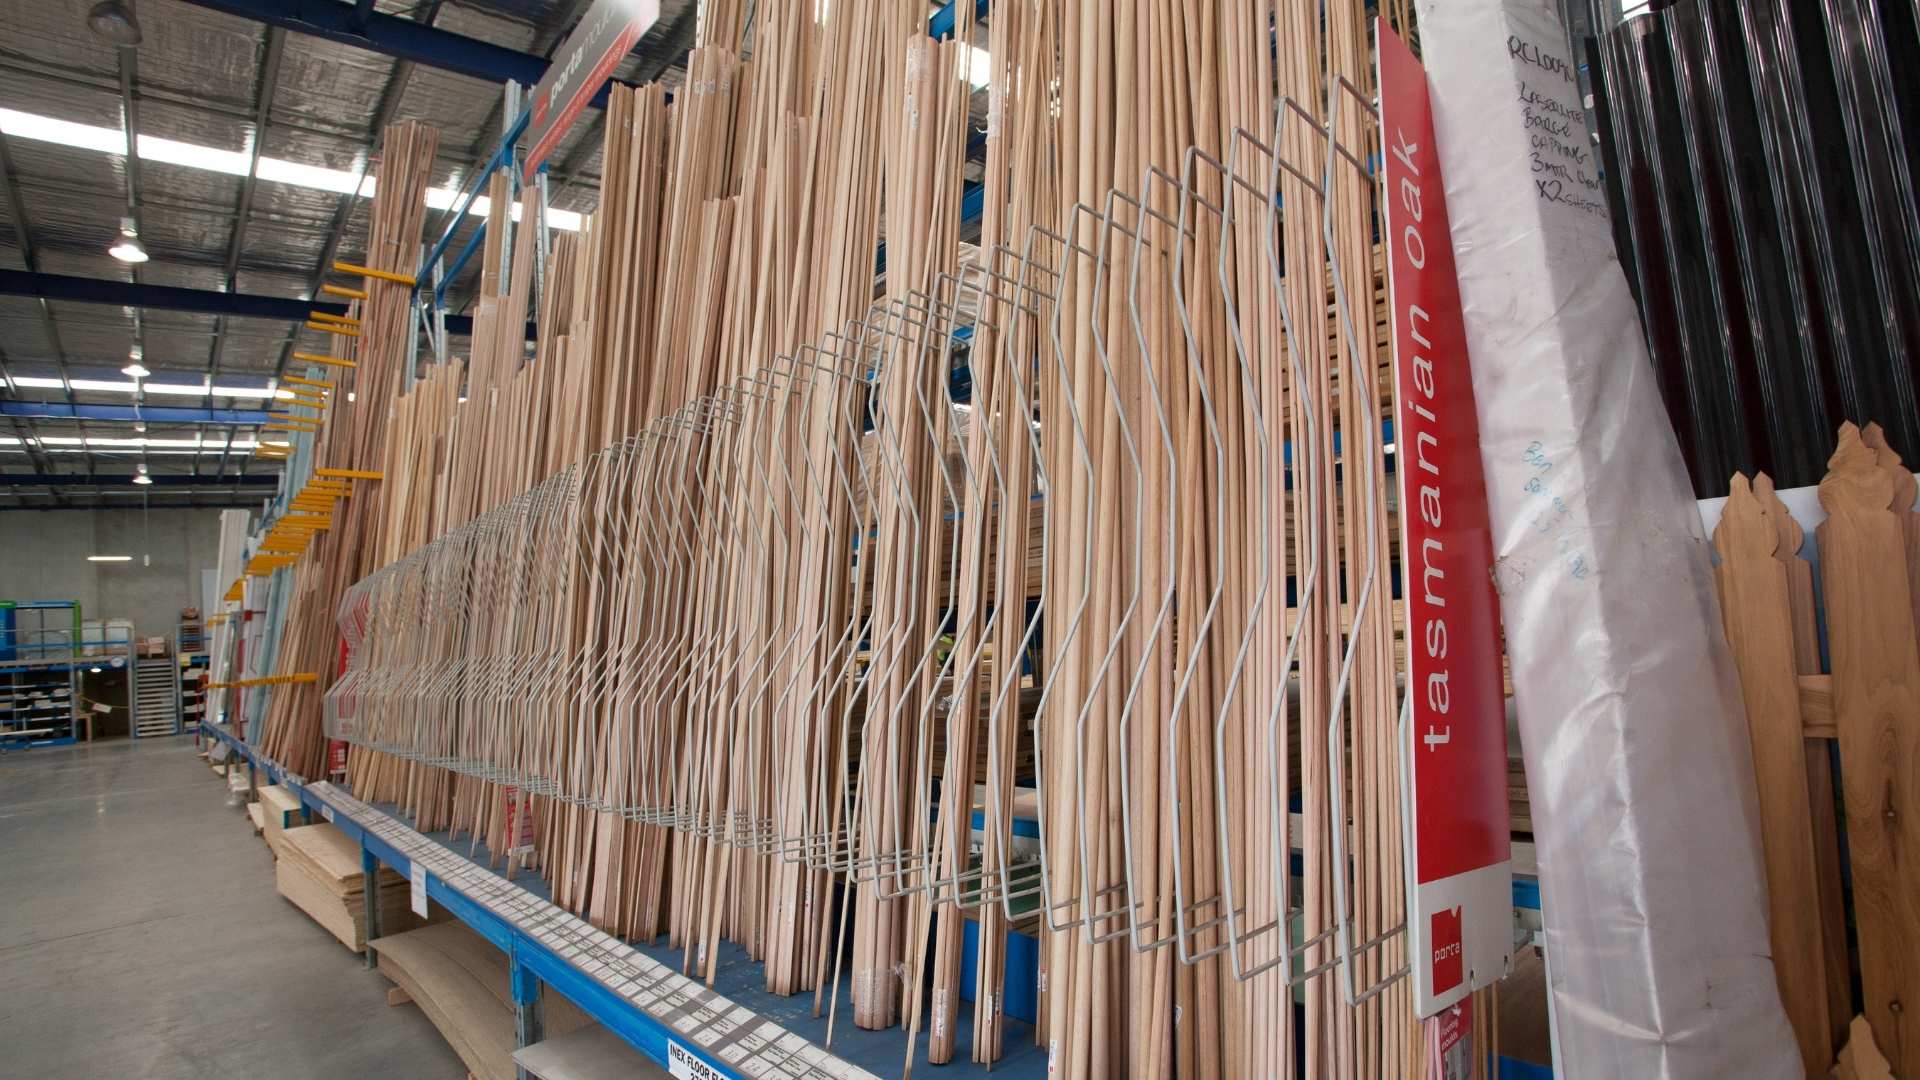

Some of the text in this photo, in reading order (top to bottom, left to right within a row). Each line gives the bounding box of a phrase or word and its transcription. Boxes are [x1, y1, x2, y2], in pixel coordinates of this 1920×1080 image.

[1392, 128, 1450, 752] tasmanian oak
[1434, 942, 1460, 964] porta
[670, 1044, 686, 1064] INEX
[687, 1056, 710, 1080] FLOOR
